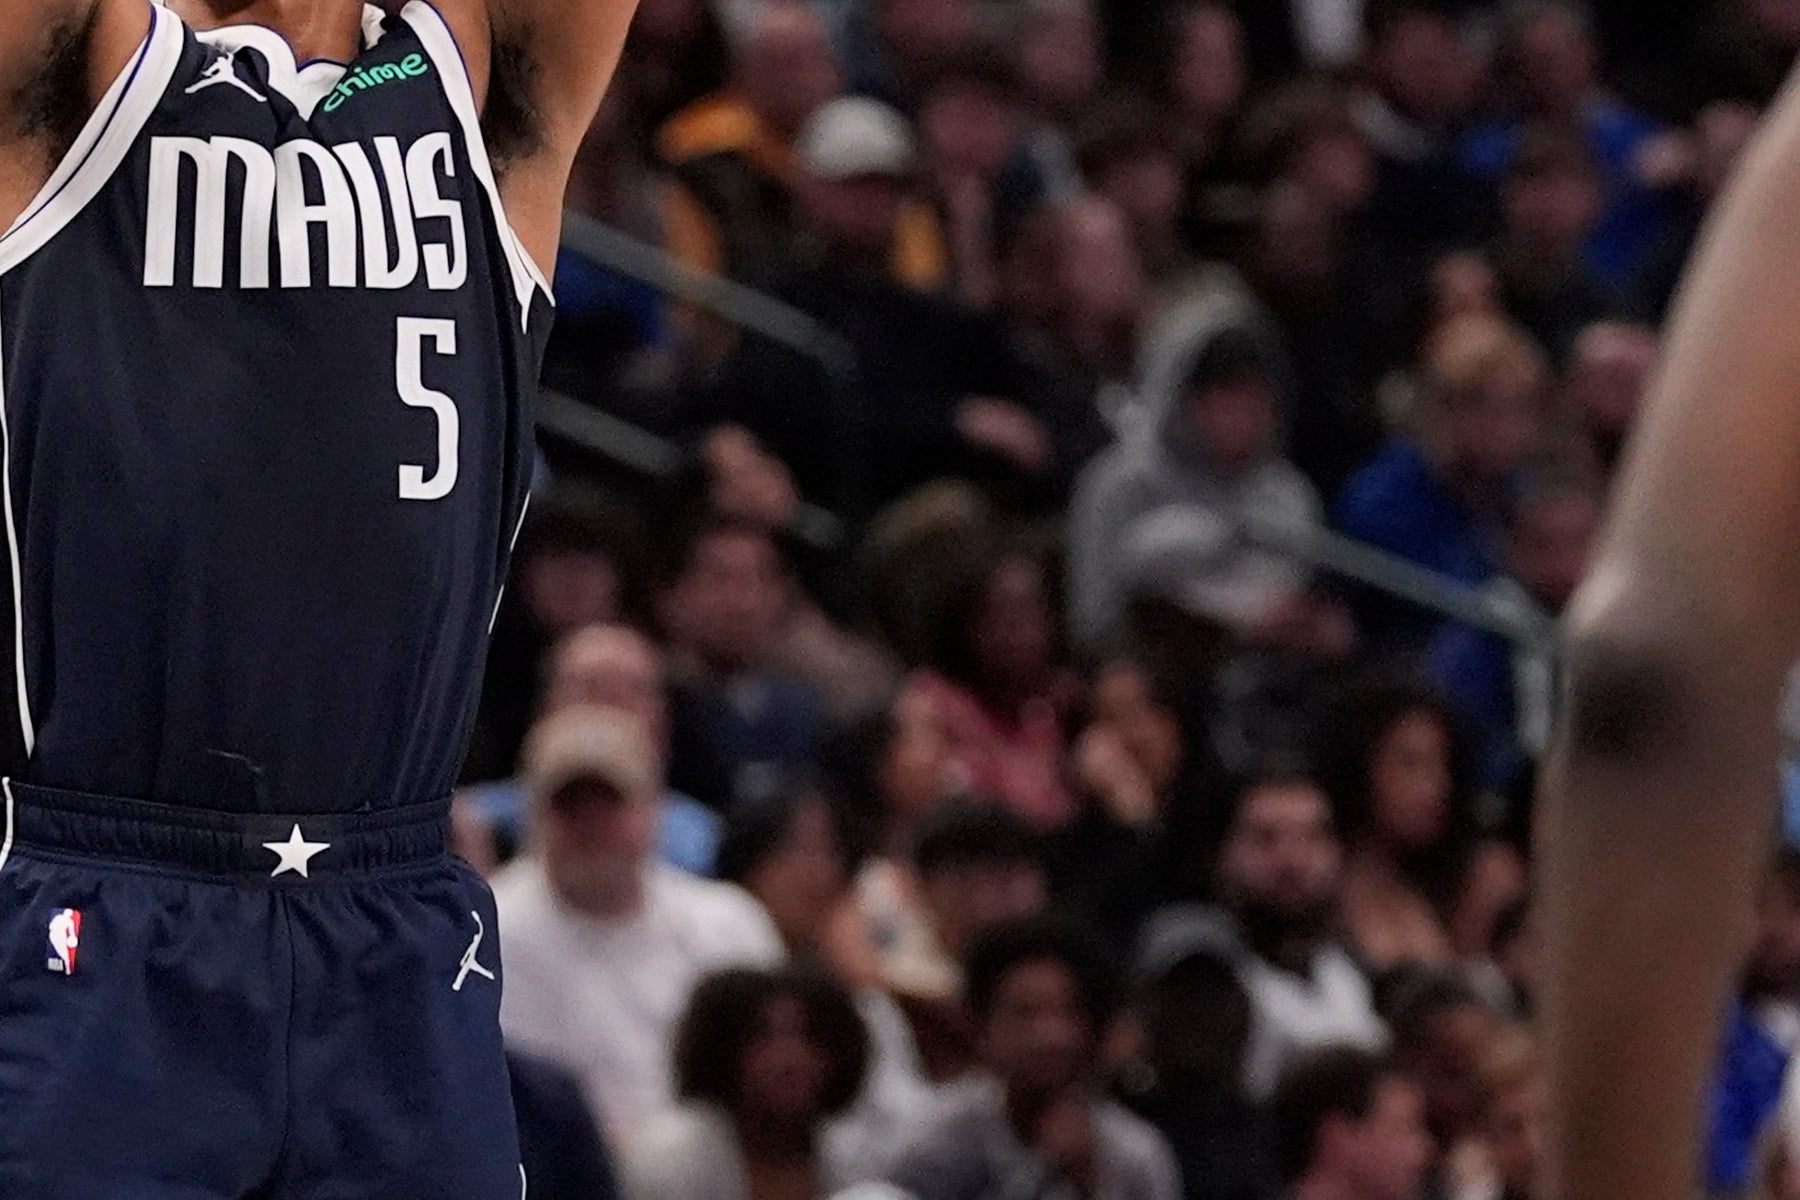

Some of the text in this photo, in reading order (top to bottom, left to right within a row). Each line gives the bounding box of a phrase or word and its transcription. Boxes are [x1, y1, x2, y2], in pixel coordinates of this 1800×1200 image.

[323, 53, 428, 112] chime
[143, 132, 468, 290] MAVS
[396, 316, 460, 500] 5
